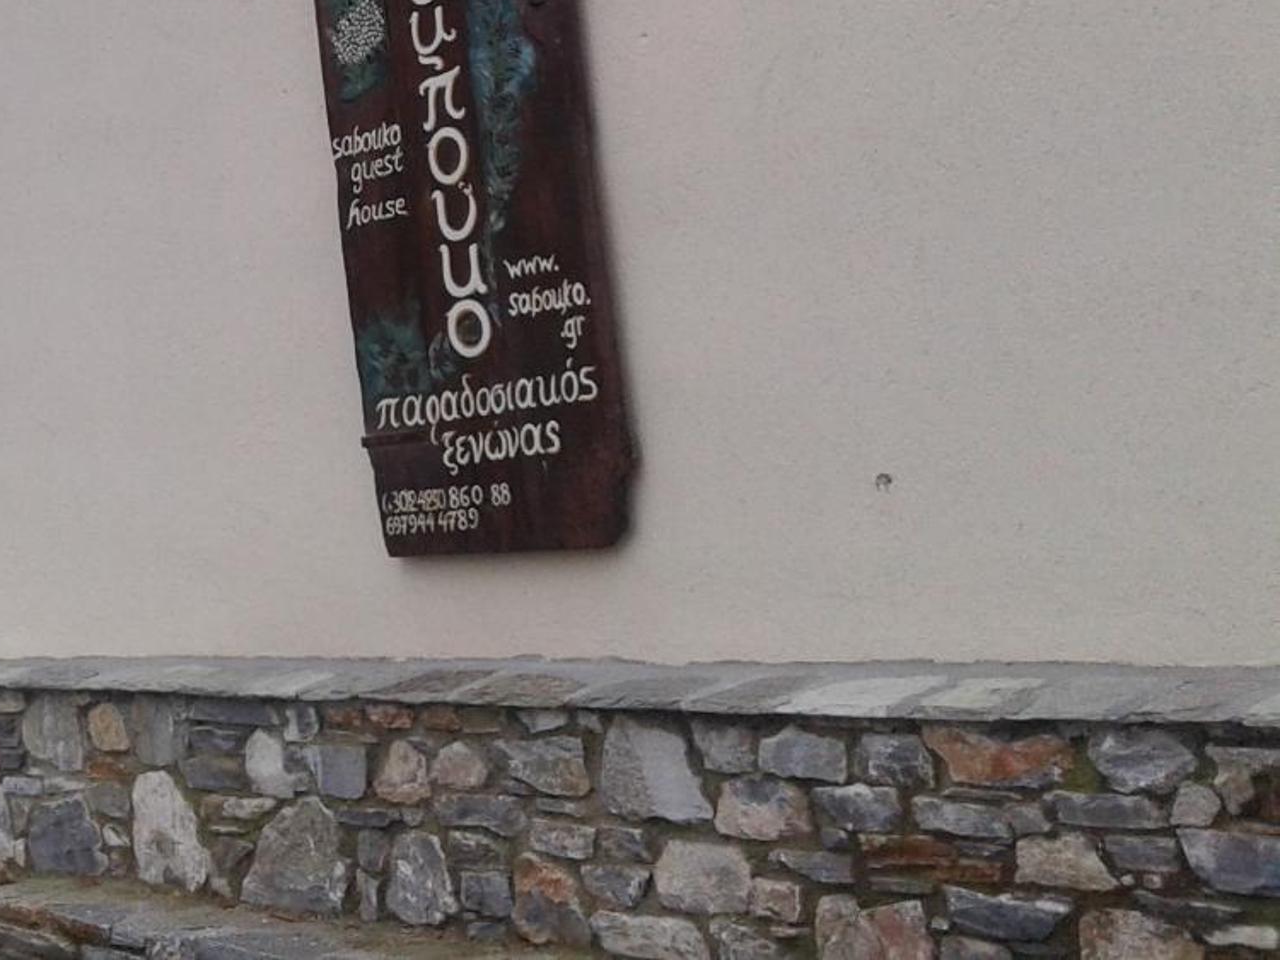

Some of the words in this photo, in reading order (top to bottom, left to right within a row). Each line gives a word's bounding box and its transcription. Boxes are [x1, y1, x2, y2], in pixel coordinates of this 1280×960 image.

[332, 122, 402, 160] sabouko
[351, 148, 404, 194] guest
[346, 197, 409, 229] house
[441, 420, 562, 476] ξενώνας
[490, 482, 512, 506] 88
